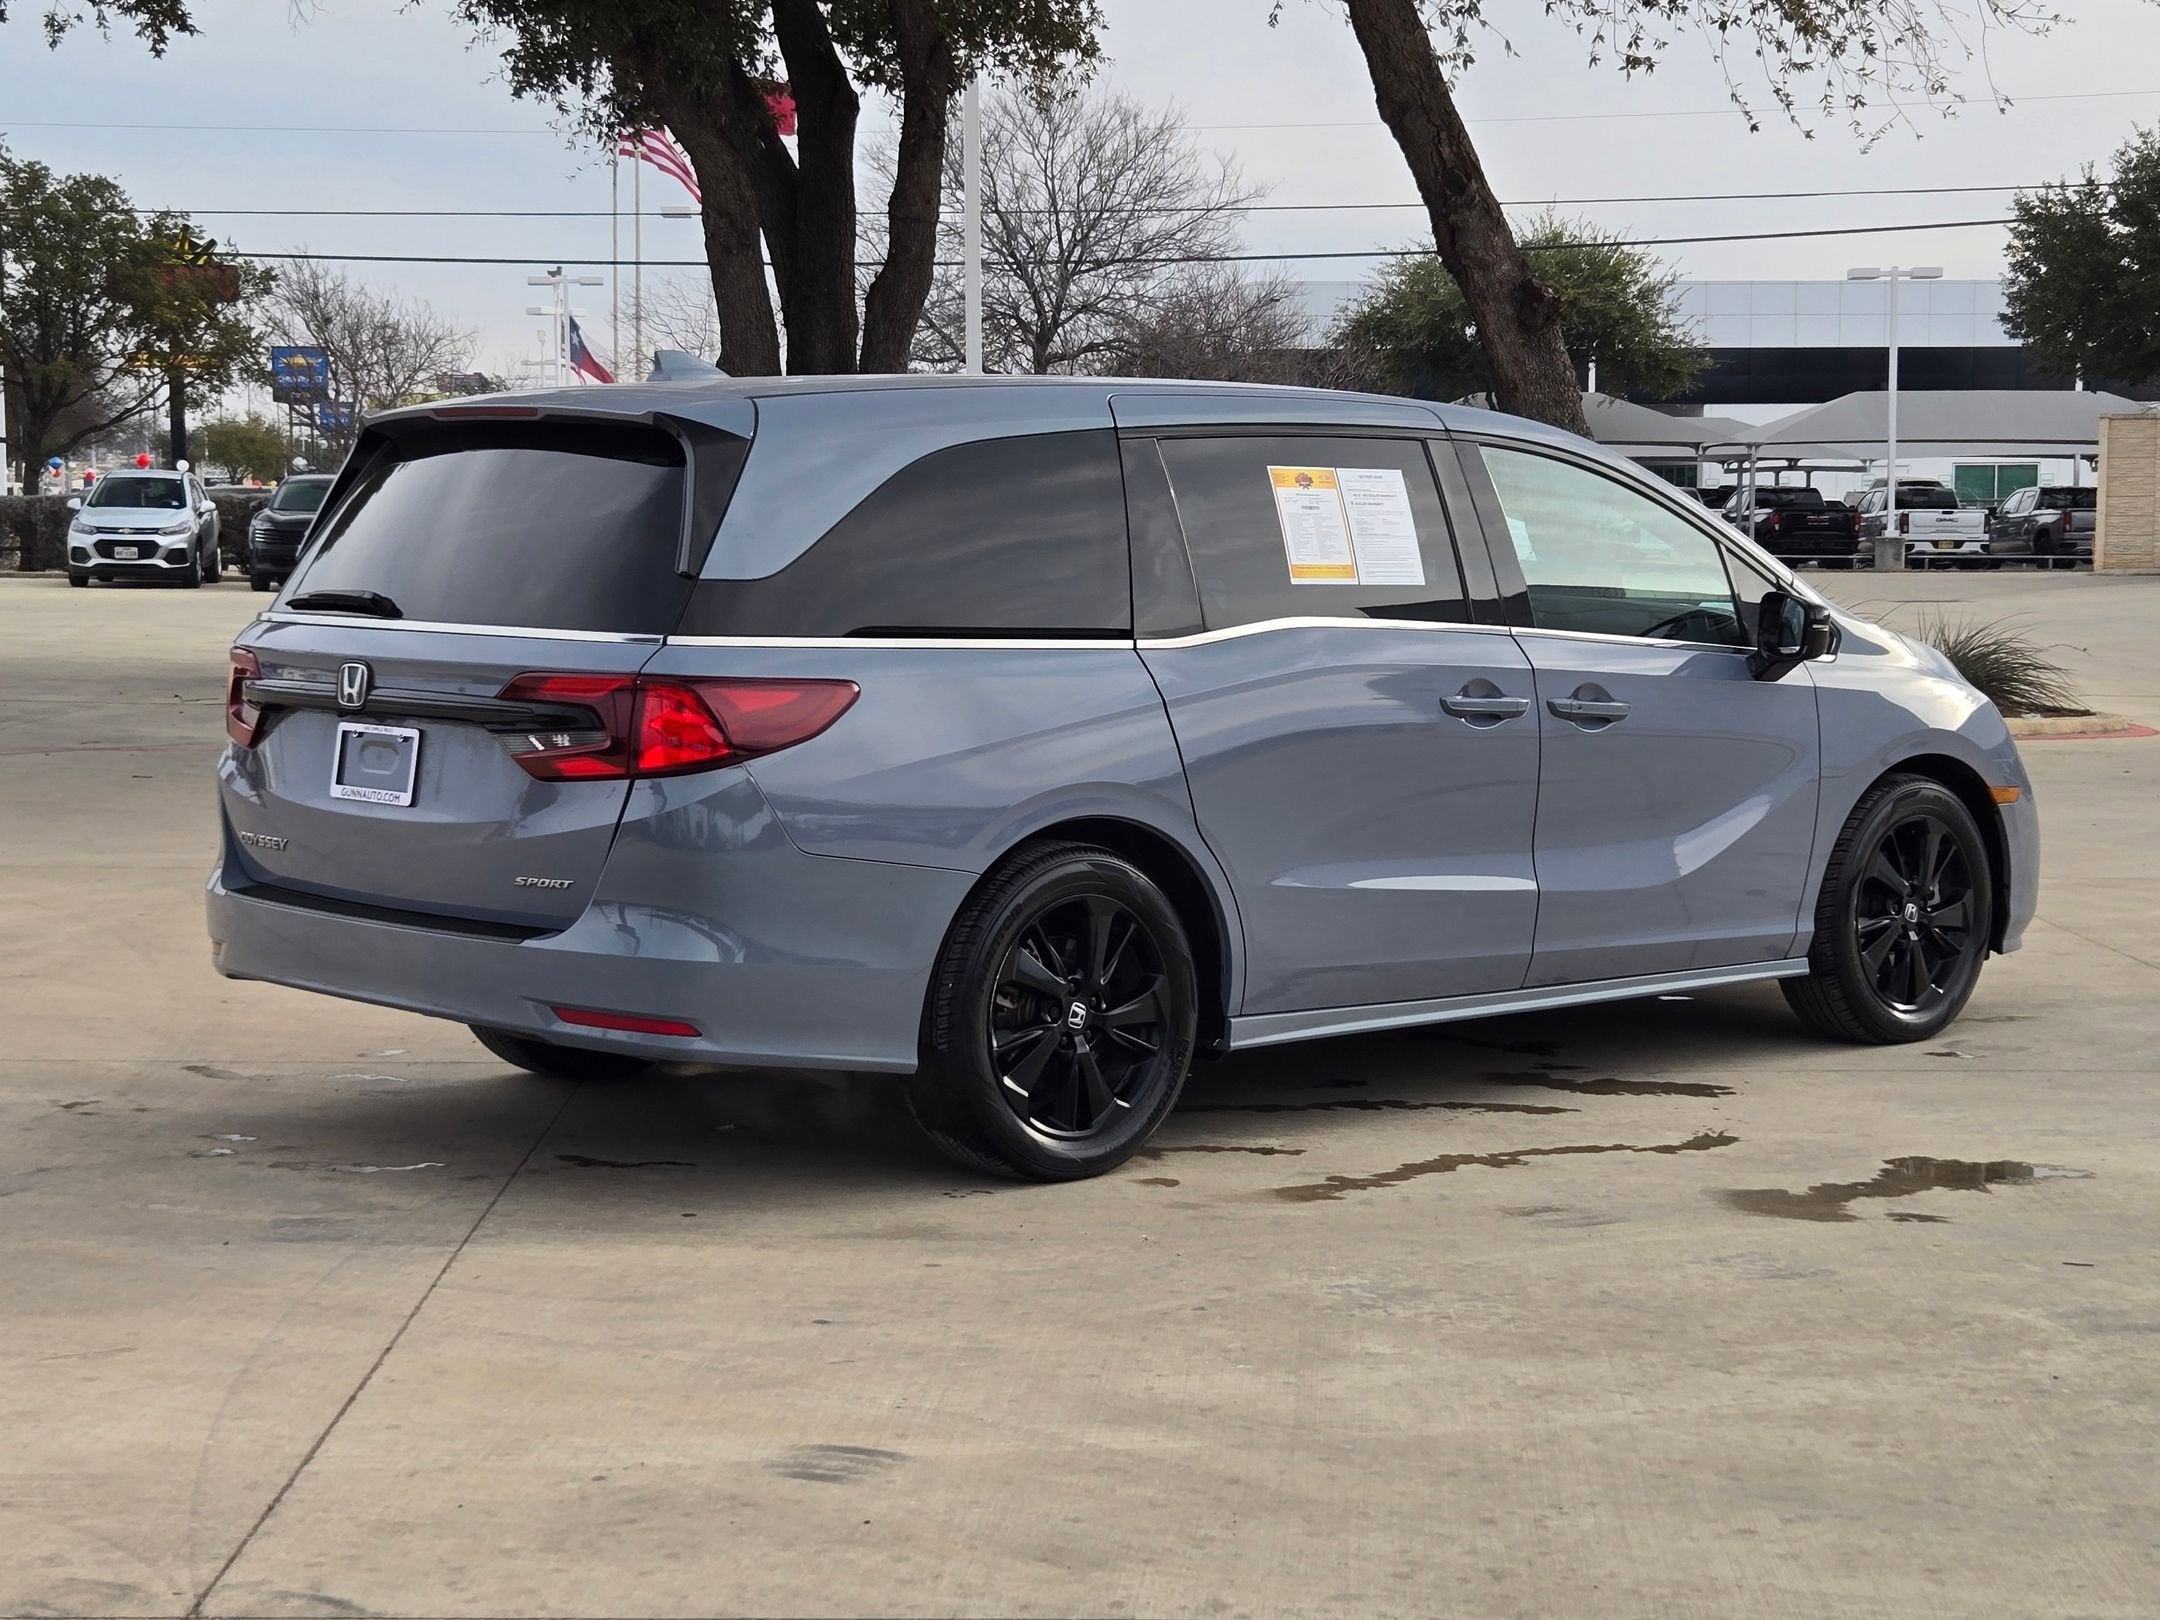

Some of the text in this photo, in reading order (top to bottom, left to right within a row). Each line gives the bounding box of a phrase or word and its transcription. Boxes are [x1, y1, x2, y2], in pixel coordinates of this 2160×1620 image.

[341, 787, 401, 803] GUNNAUTO.COM
[240, 831, 289, 851] ODYSSEY
[514, 876, 575, 889] SPORT
